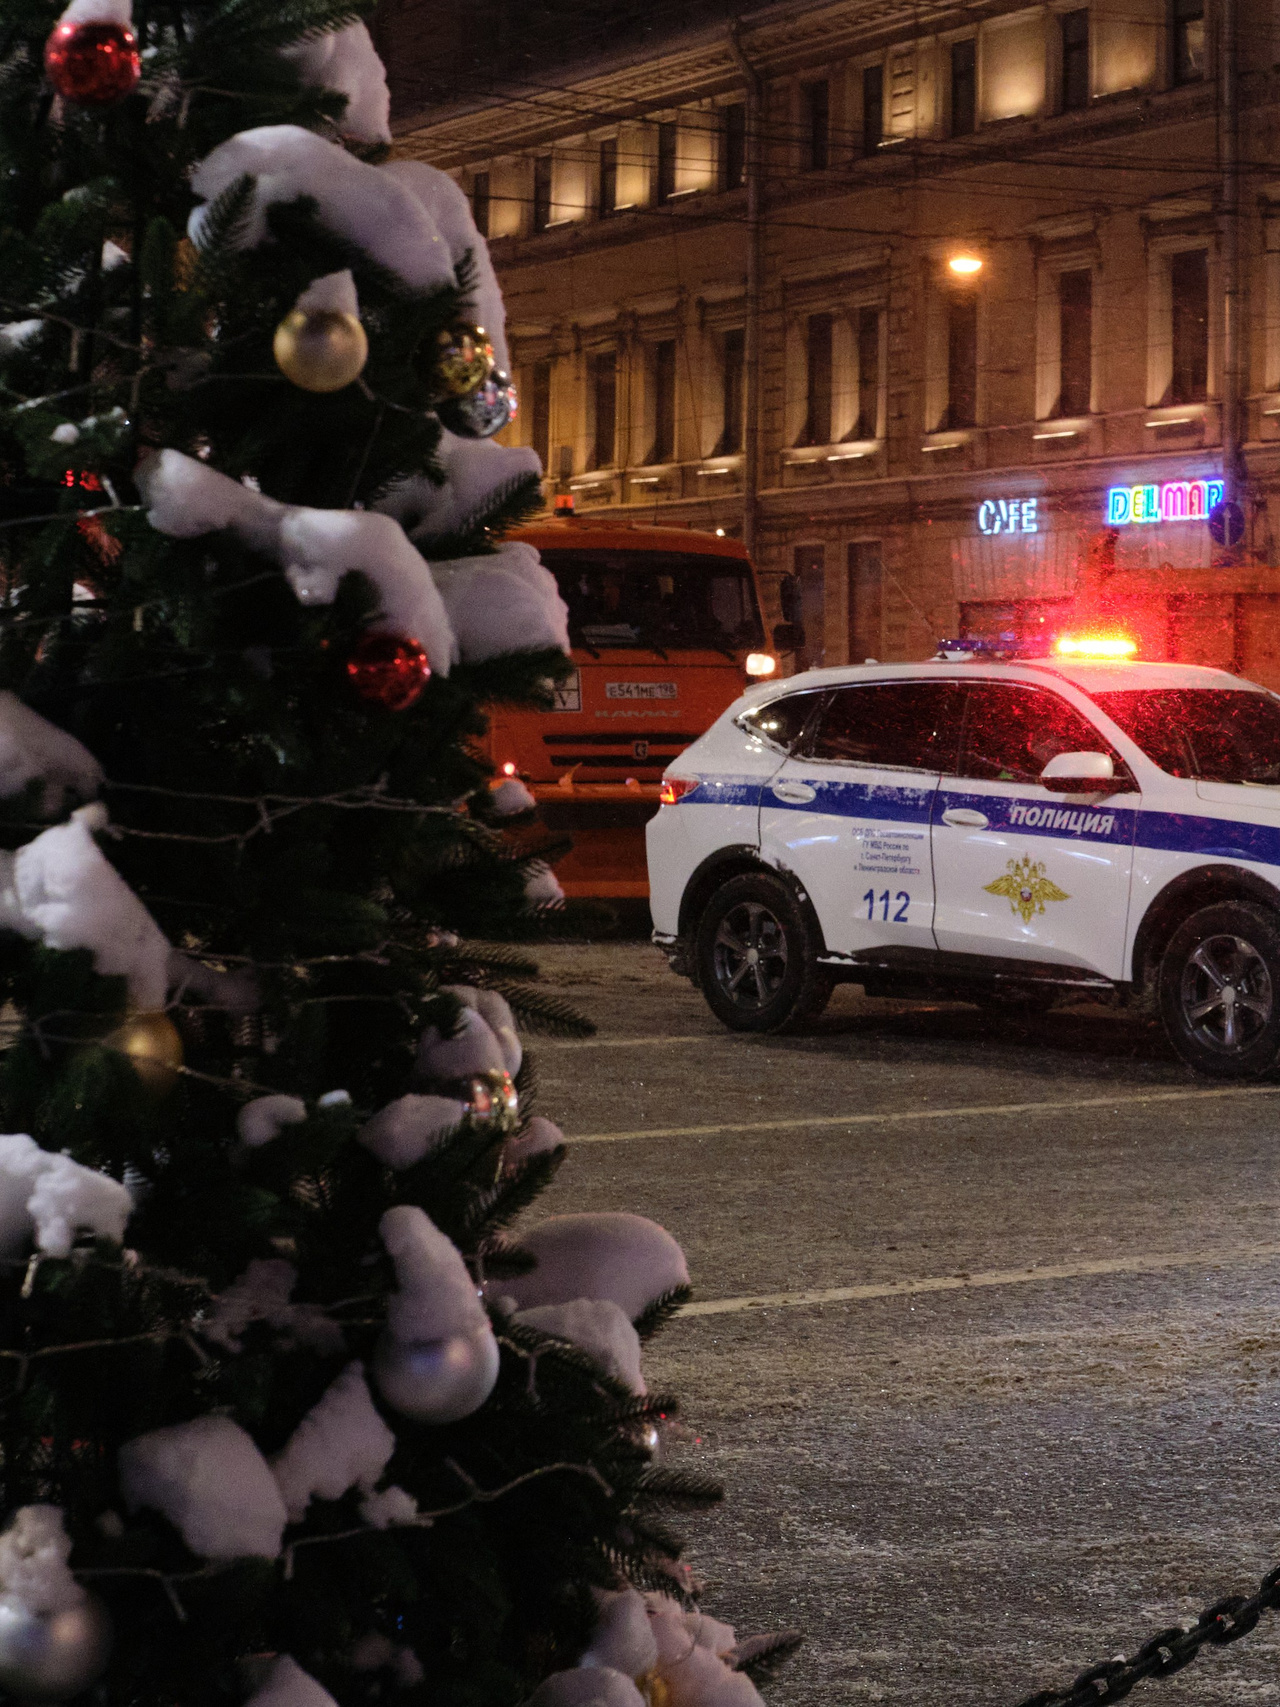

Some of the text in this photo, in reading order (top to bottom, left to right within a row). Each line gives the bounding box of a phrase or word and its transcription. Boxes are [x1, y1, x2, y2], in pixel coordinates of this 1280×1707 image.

[978, 498, 1038, 535] CAFE
[1009, 804, 1115, 836] ПОЛИЦИЯ
[863, 888, 910, 923] 112
